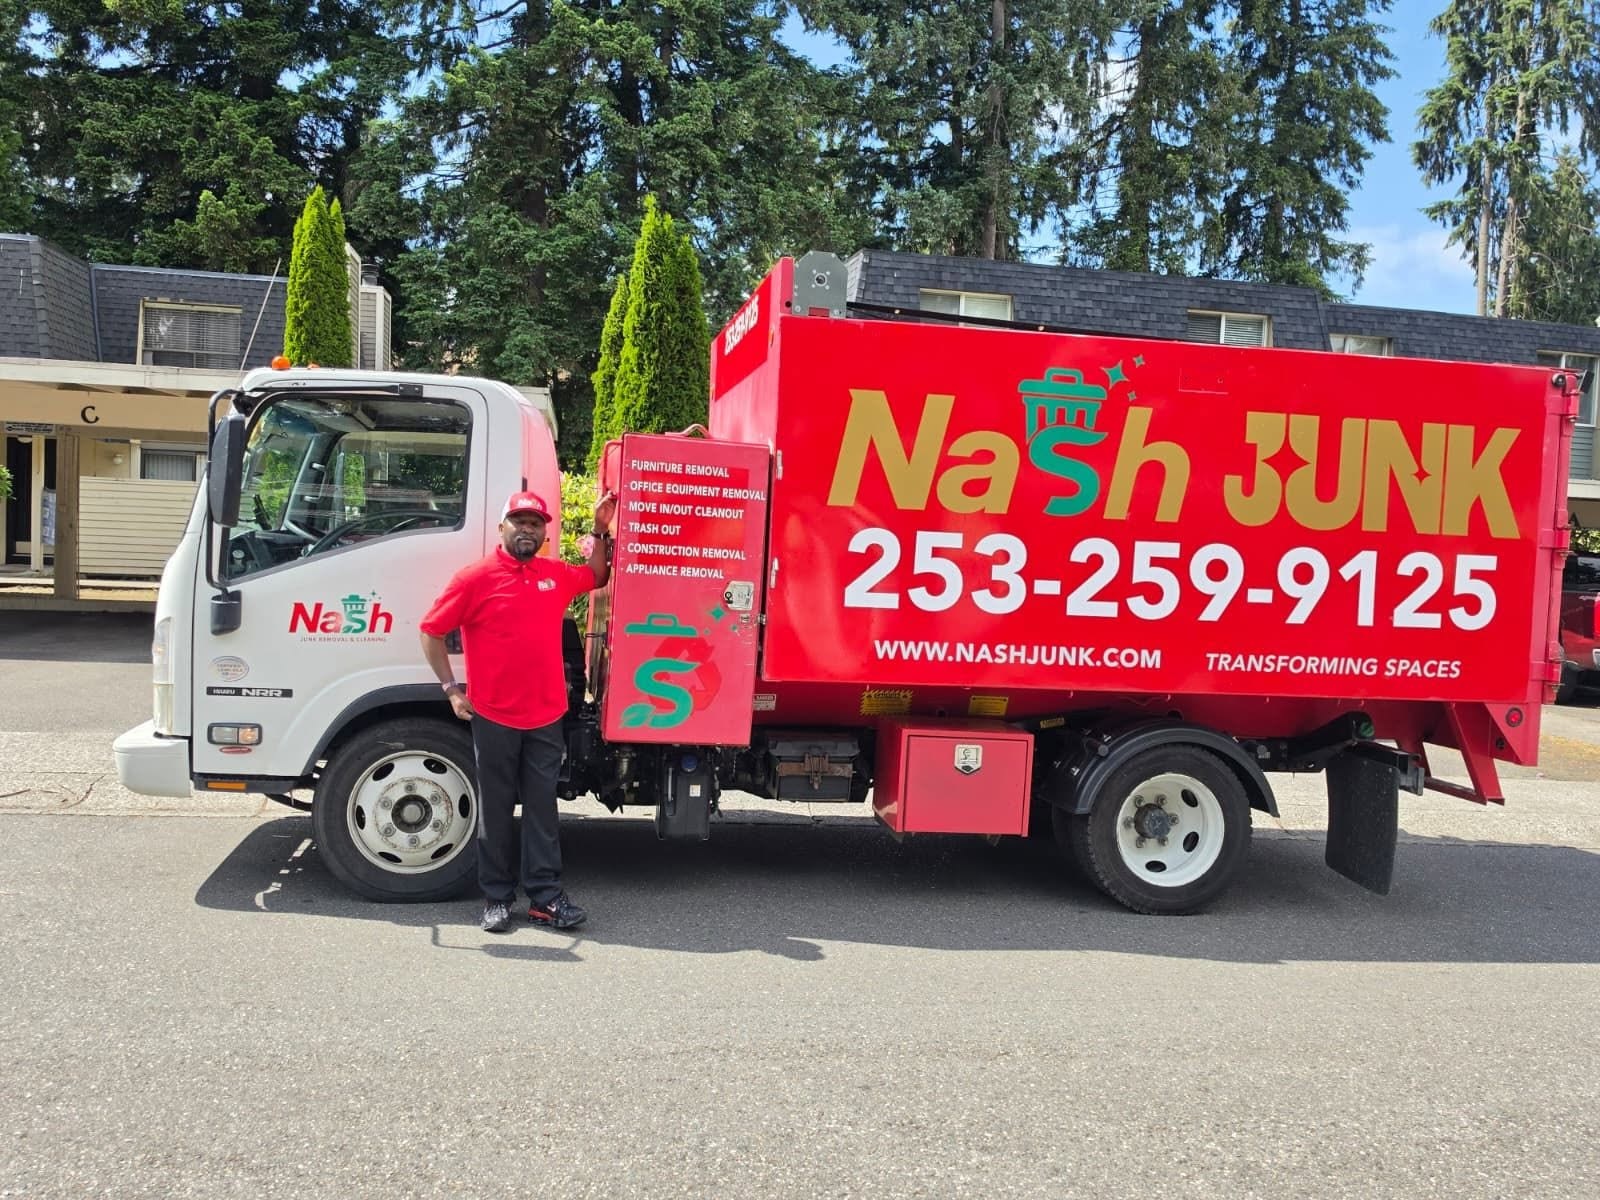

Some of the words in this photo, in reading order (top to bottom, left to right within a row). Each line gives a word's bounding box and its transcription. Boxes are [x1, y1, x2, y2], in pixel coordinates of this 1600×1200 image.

[80, 405, 100, 424] C
[631, 459, 683, 474] FURNITURE
[685, 464, 730, 478] REMOVAL
[826, 388, 1191, 523] Nash
[1223, 410, 1522, 540] JUNK
[630, 480, 663, 493] OFFICE
[665, 483, 720, 498] EQUIPMENT
[722, 488, 766, 501] REMOVAL
[628, 501, 657, 514] MOVE
[659, 504, 692, 517] IN/OUT
[694, 506, 744, 519] CLEANOUT
[628, 522, 659, 534] TRASH
[661, 525, 681, 536] OUT
[627, 542, 700, 558] CONSTRUCTION
[702, 548, 746, 561] REMOVAL
[626, 563, 678, 576] APPLIANCE
[680, 567, 725, 579] REMOVAL
[843, 527, 1498, 631] 253-259-9125
[288, 602, 393, 634] Nash
[874, 639, 1162, 669] WWW.NASHJUNK.COM
[1206, 653, 1378, 676] TRANSFORMING
[1384, 659, 1461, 679] SPACES
[241, 688, 282, 697] NRR
